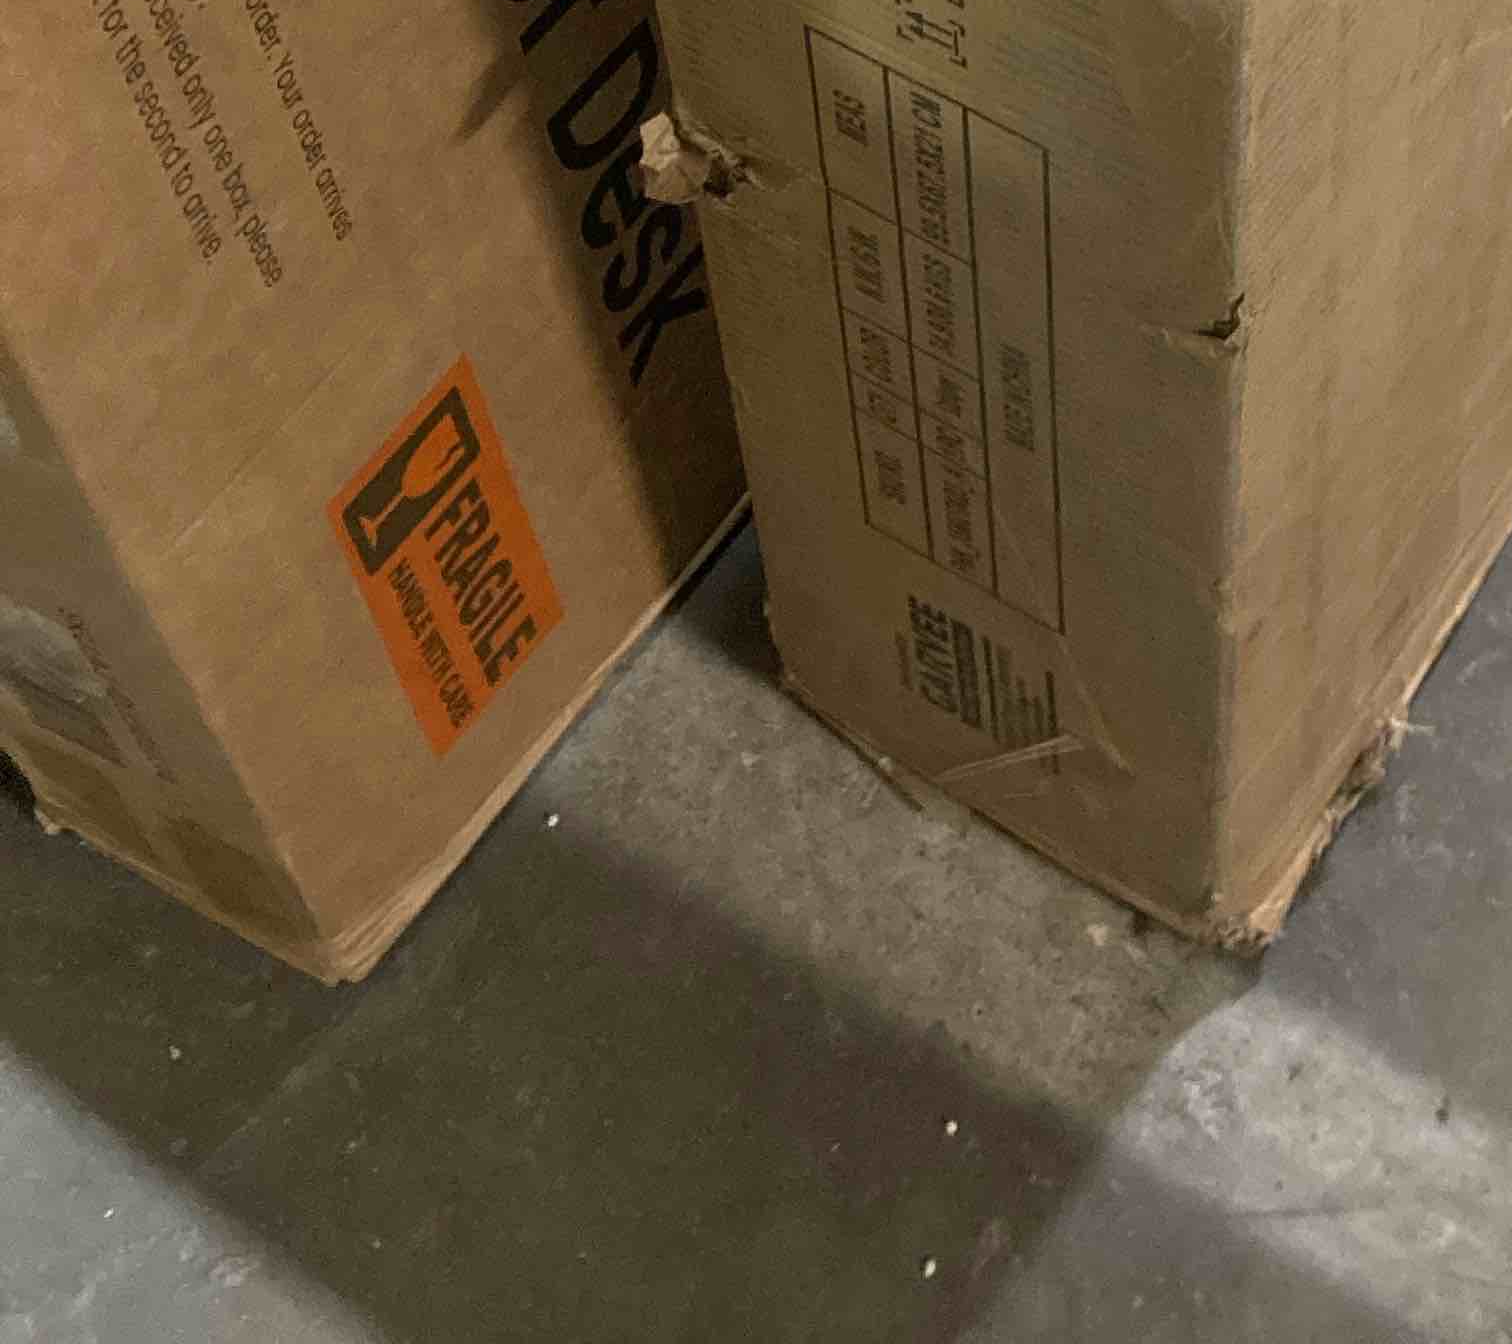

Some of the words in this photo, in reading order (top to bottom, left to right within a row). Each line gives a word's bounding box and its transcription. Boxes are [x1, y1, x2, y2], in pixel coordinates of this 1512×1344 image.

[114, 32, 148, 85] the
[132, 79, 190, 171] second
[169, 160, 195, 198] to
[180, 72, 218, 131] only
[201, 123, 234, 173] one
[272, 49, 305, 110] Your
[291, 108, 328, 172] order
[546, 18, 706, 386] Desk
[425, 478, 536, 687] FRAGILE
